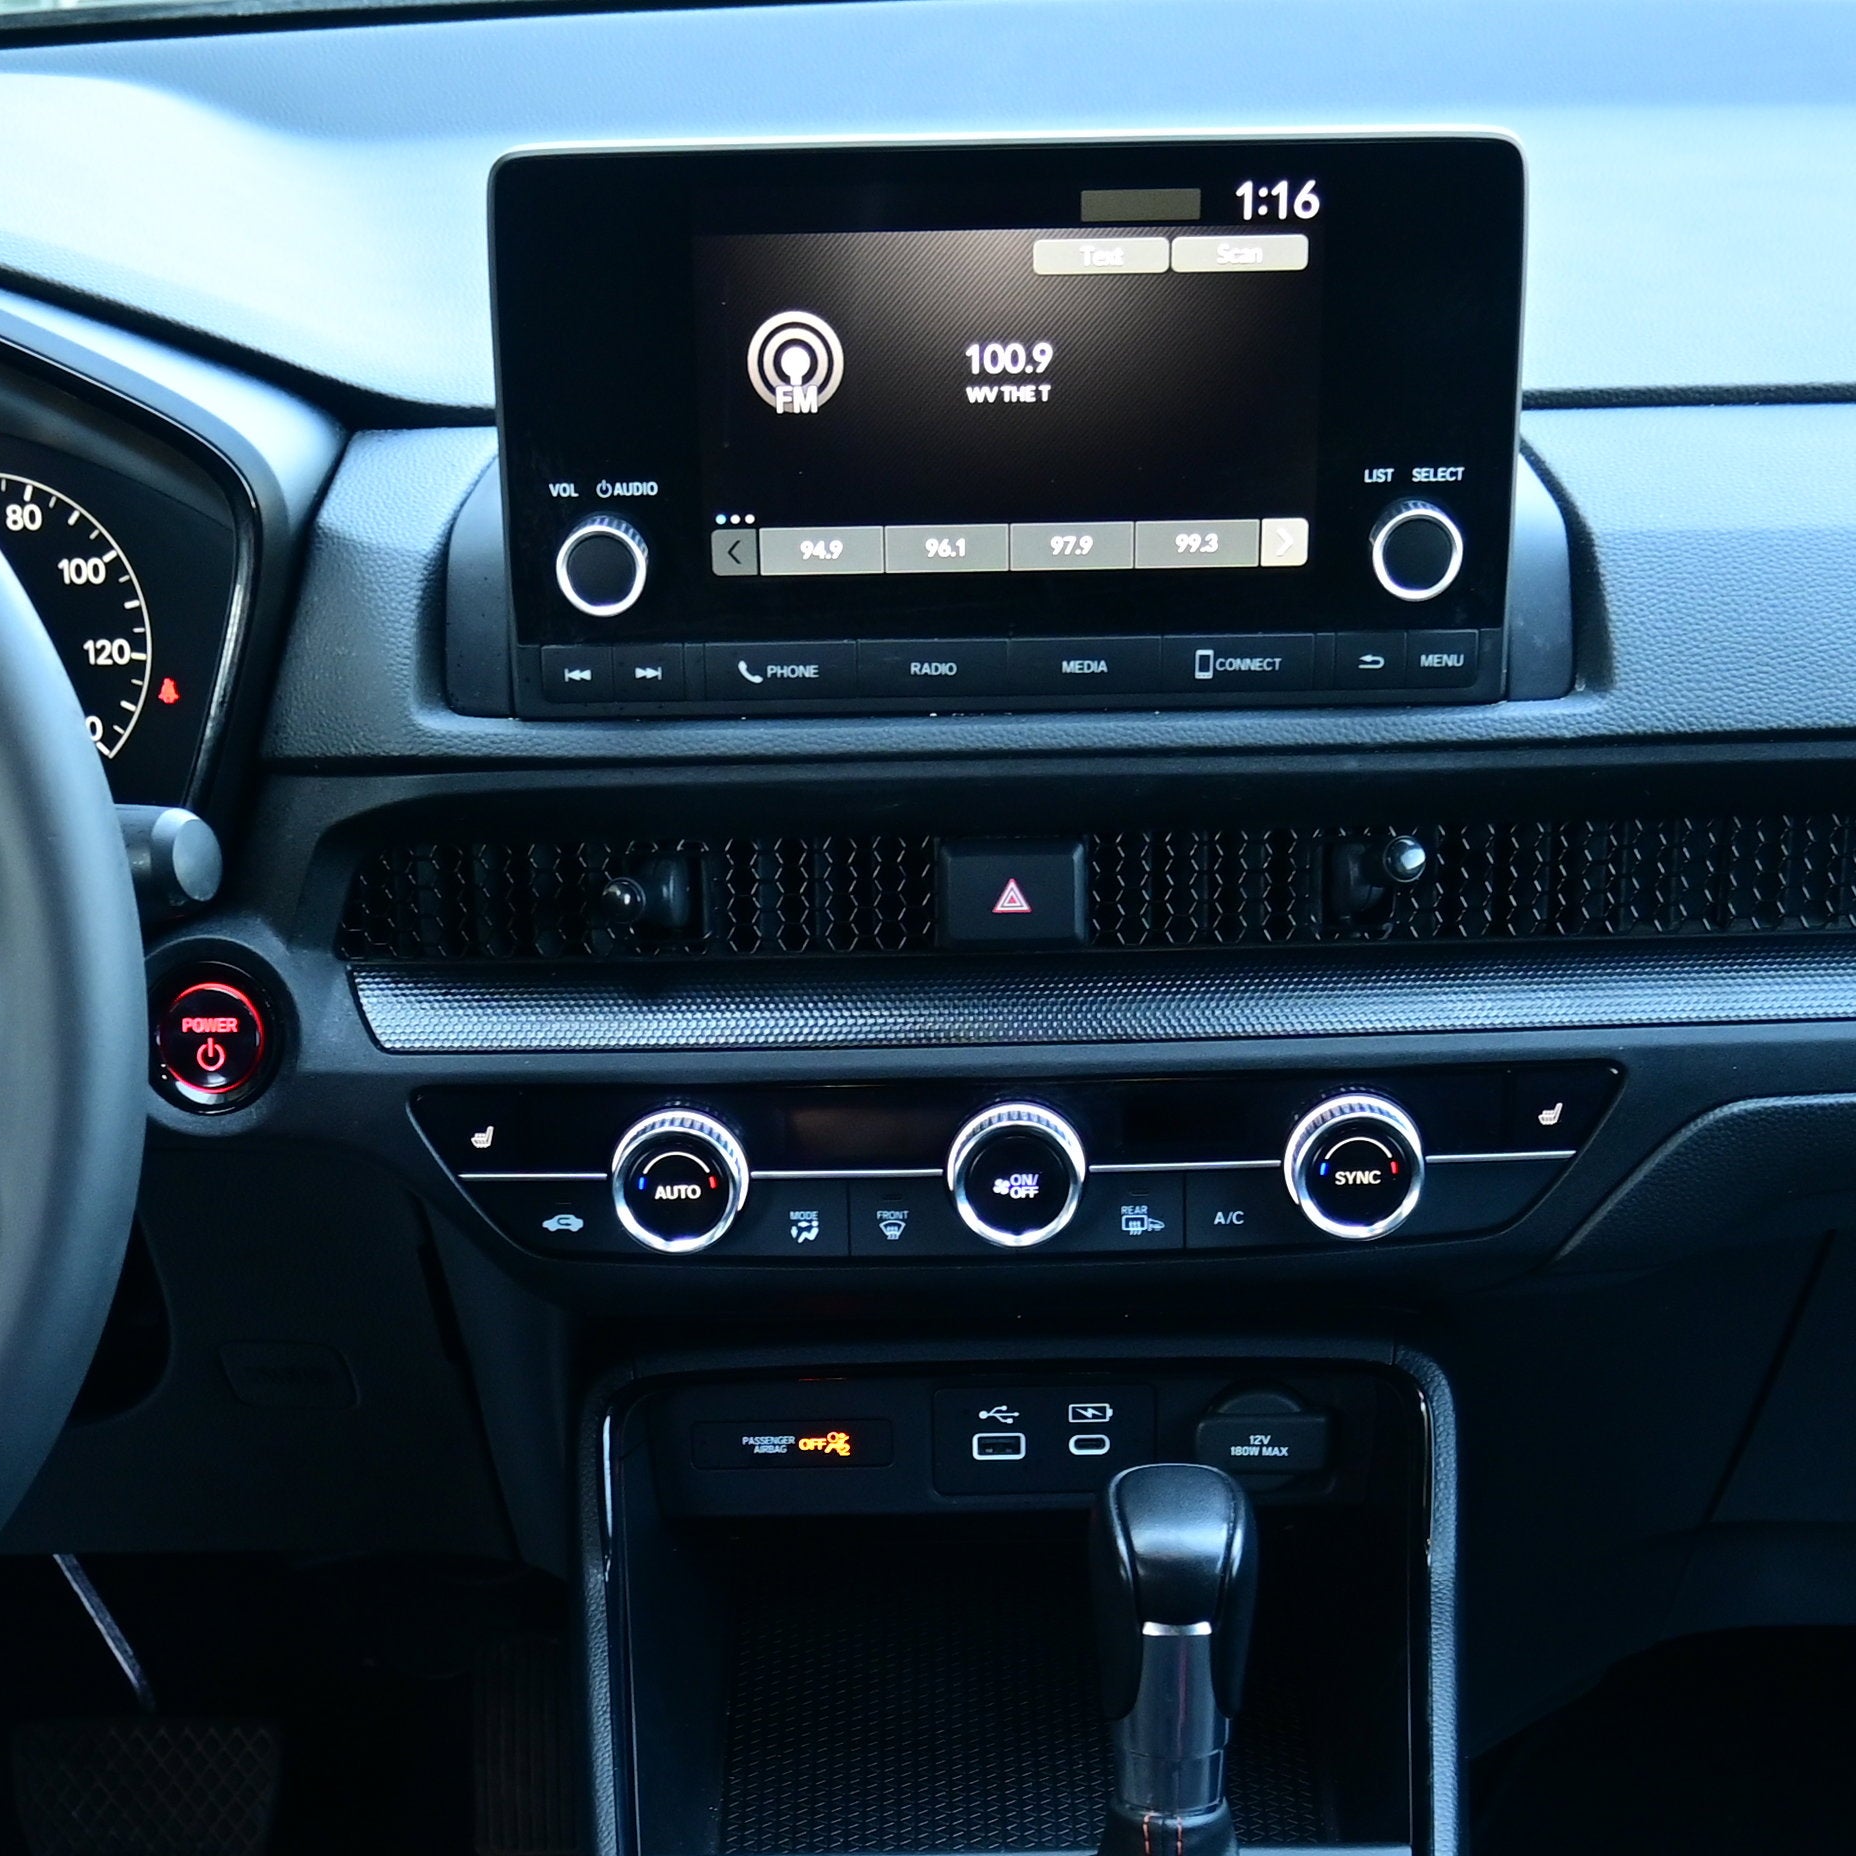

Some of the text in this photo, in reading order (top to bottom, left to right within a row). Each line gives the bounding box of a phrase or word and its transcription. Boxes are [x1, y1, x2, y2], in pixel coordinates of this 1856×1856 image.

[1235, 179, 1320, 221] 1:16
[1076, 242, 1126, 270] Text
[1215, 242, 1264, 266] Scan
[963, 341, 1055, 375] 100.9
[775, 385, 818, 415] FM
[964, 383, 1052, 405] WV THE T
[1364, 466, 1465, 483] LIST SELECT
[548, 481, 659, 498] VOL AUDIO
[5, 503, 42, 531] 80
[800, 540, 844, 559] 94.9
[924, 538, 967, 557] 96.1
[1049, 536, 1094, 555] 97.9
[1174, 533, 1219, 553] 99.3
[57, 557, 106, 585] 100
[83, 638, 131, 666] 120
[1420, 653, 1465, 667] MENU
[766, 664, 819, 678] PHONE
[910, 662, 958, 676] RADIO
[1061, 659, 1108, 674] MEDIA
[1215, 657, 1282, 671] CONNECT
[181, 1017, 238, 1033] POWER
[1009, 1173, 1039, 1187] ON/
[1334, 1169, 1382, 1186] SYNC
[654, 1184, 702, 1200] AUTO
[1009, 1186, 1040, 1199] OFF
[789, 1210, 818, 1221] MODE
[876, 1210, 909, 1220] FRONT
[1121, 1205, 1148, 1215] REAR
[1213, 1210, 1244, 1225] A/C
[741, 1434, 796, 1445] PASSENGER
[798, 1438, 827, 1451] OFF
[1248, 1434, 1271, 1446] 12V
[753, 1444, 788, 1454] AIRBAG
[1229, 1445, 1289, 1457] 180W MAX
